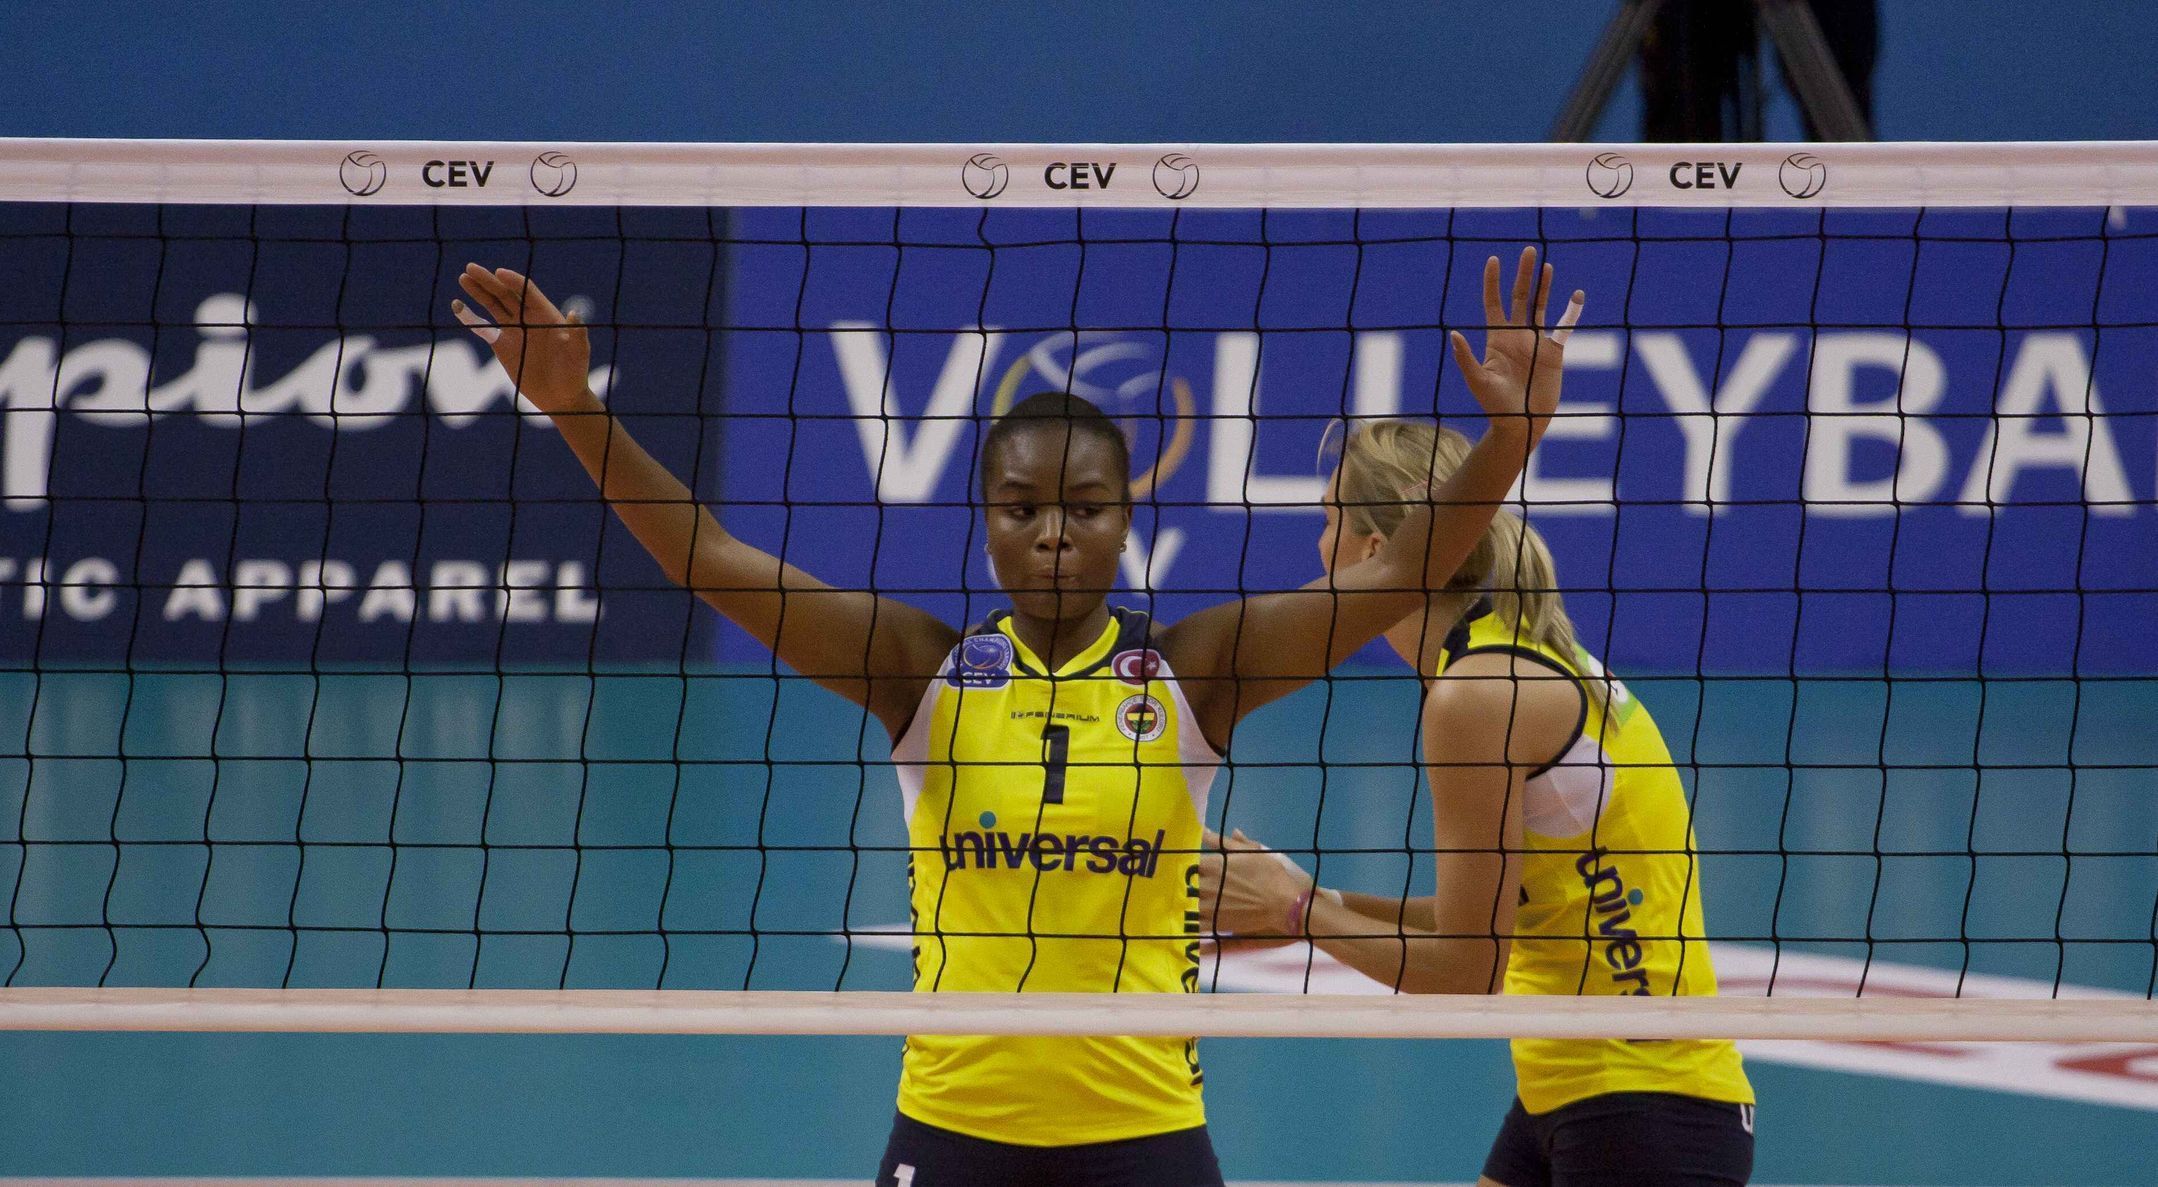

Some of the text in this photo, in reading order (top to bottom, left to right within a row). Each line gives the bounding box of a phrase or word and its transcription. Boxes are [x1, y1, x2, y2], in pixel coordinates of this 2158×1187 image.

[423, 160, 494, 187] CEV
[1045, 162, 1116, 189] CEV
[1670, 162, 1742, 189] CEV
[164, 558, 602, 622] APPAREL
[1041, 724, 1069, 805] 1
[939, 810, 1165, 878] universal
[1575, 845, 1652, 996] univer
